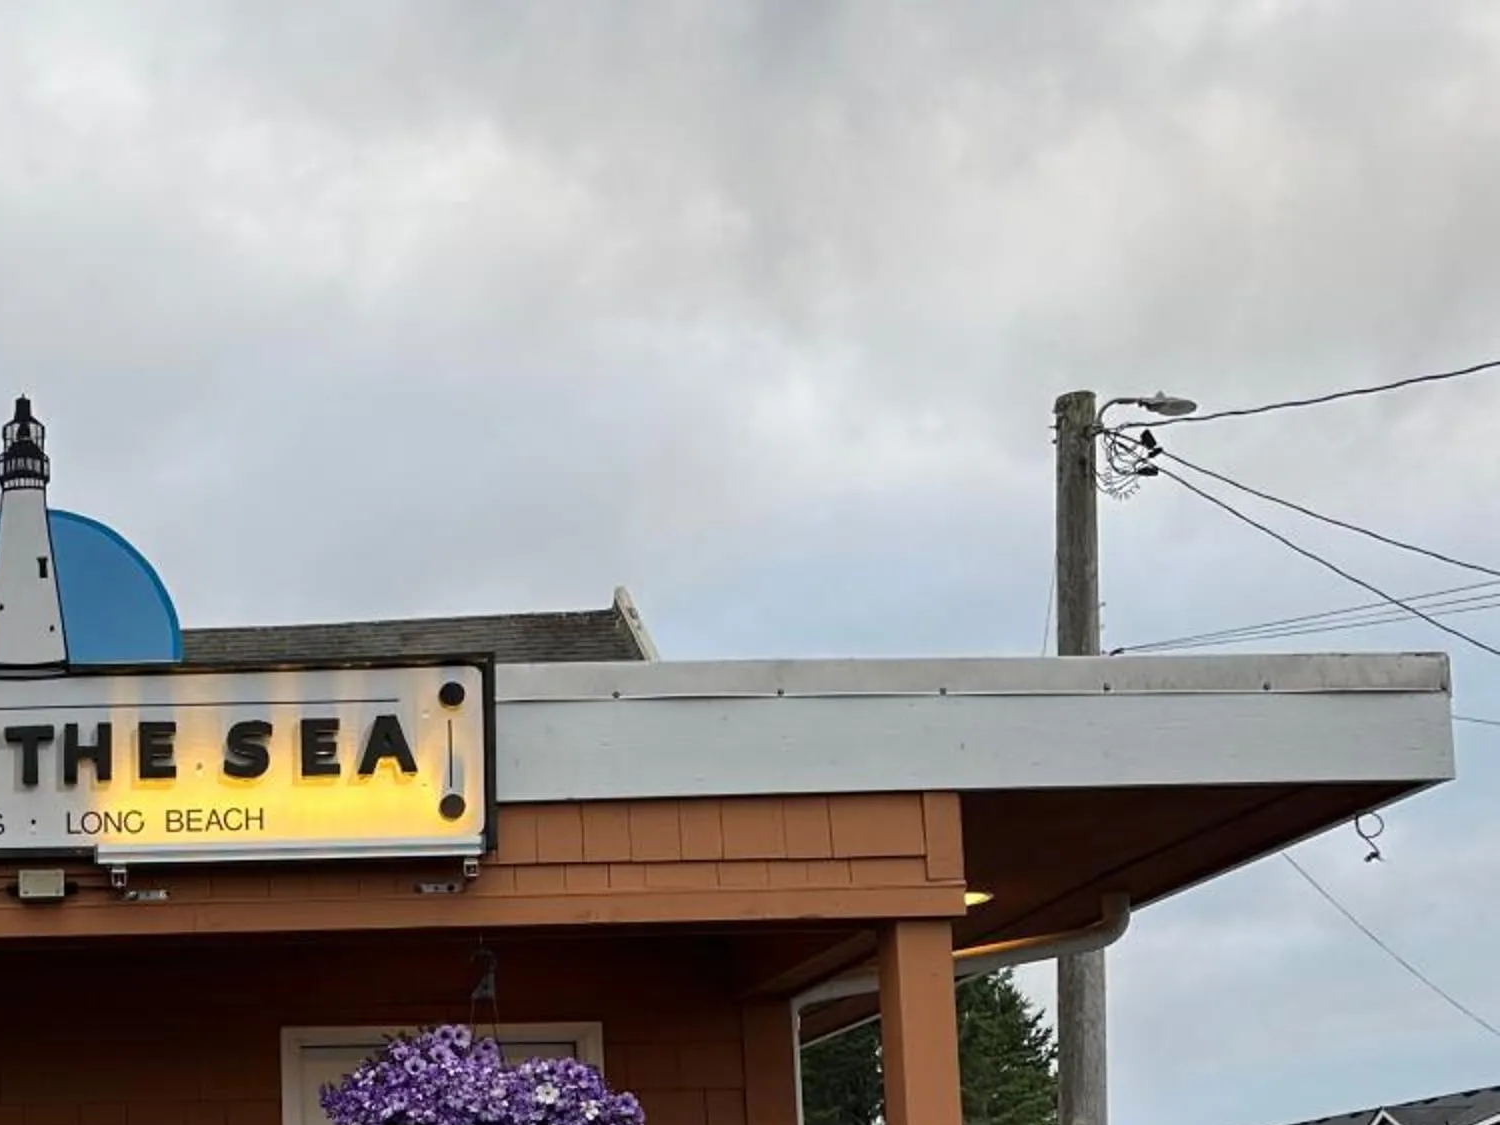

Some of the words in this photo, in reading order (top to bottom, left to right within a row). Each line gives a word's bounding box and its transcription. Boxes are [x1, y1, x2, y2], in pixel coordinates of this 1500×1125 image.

[4, 721, 178, 786] THE
[222, 714, 419, 779] SEA
[65, 809, 145, 835] LONG
[165, 807, 265, 833] BEACH
